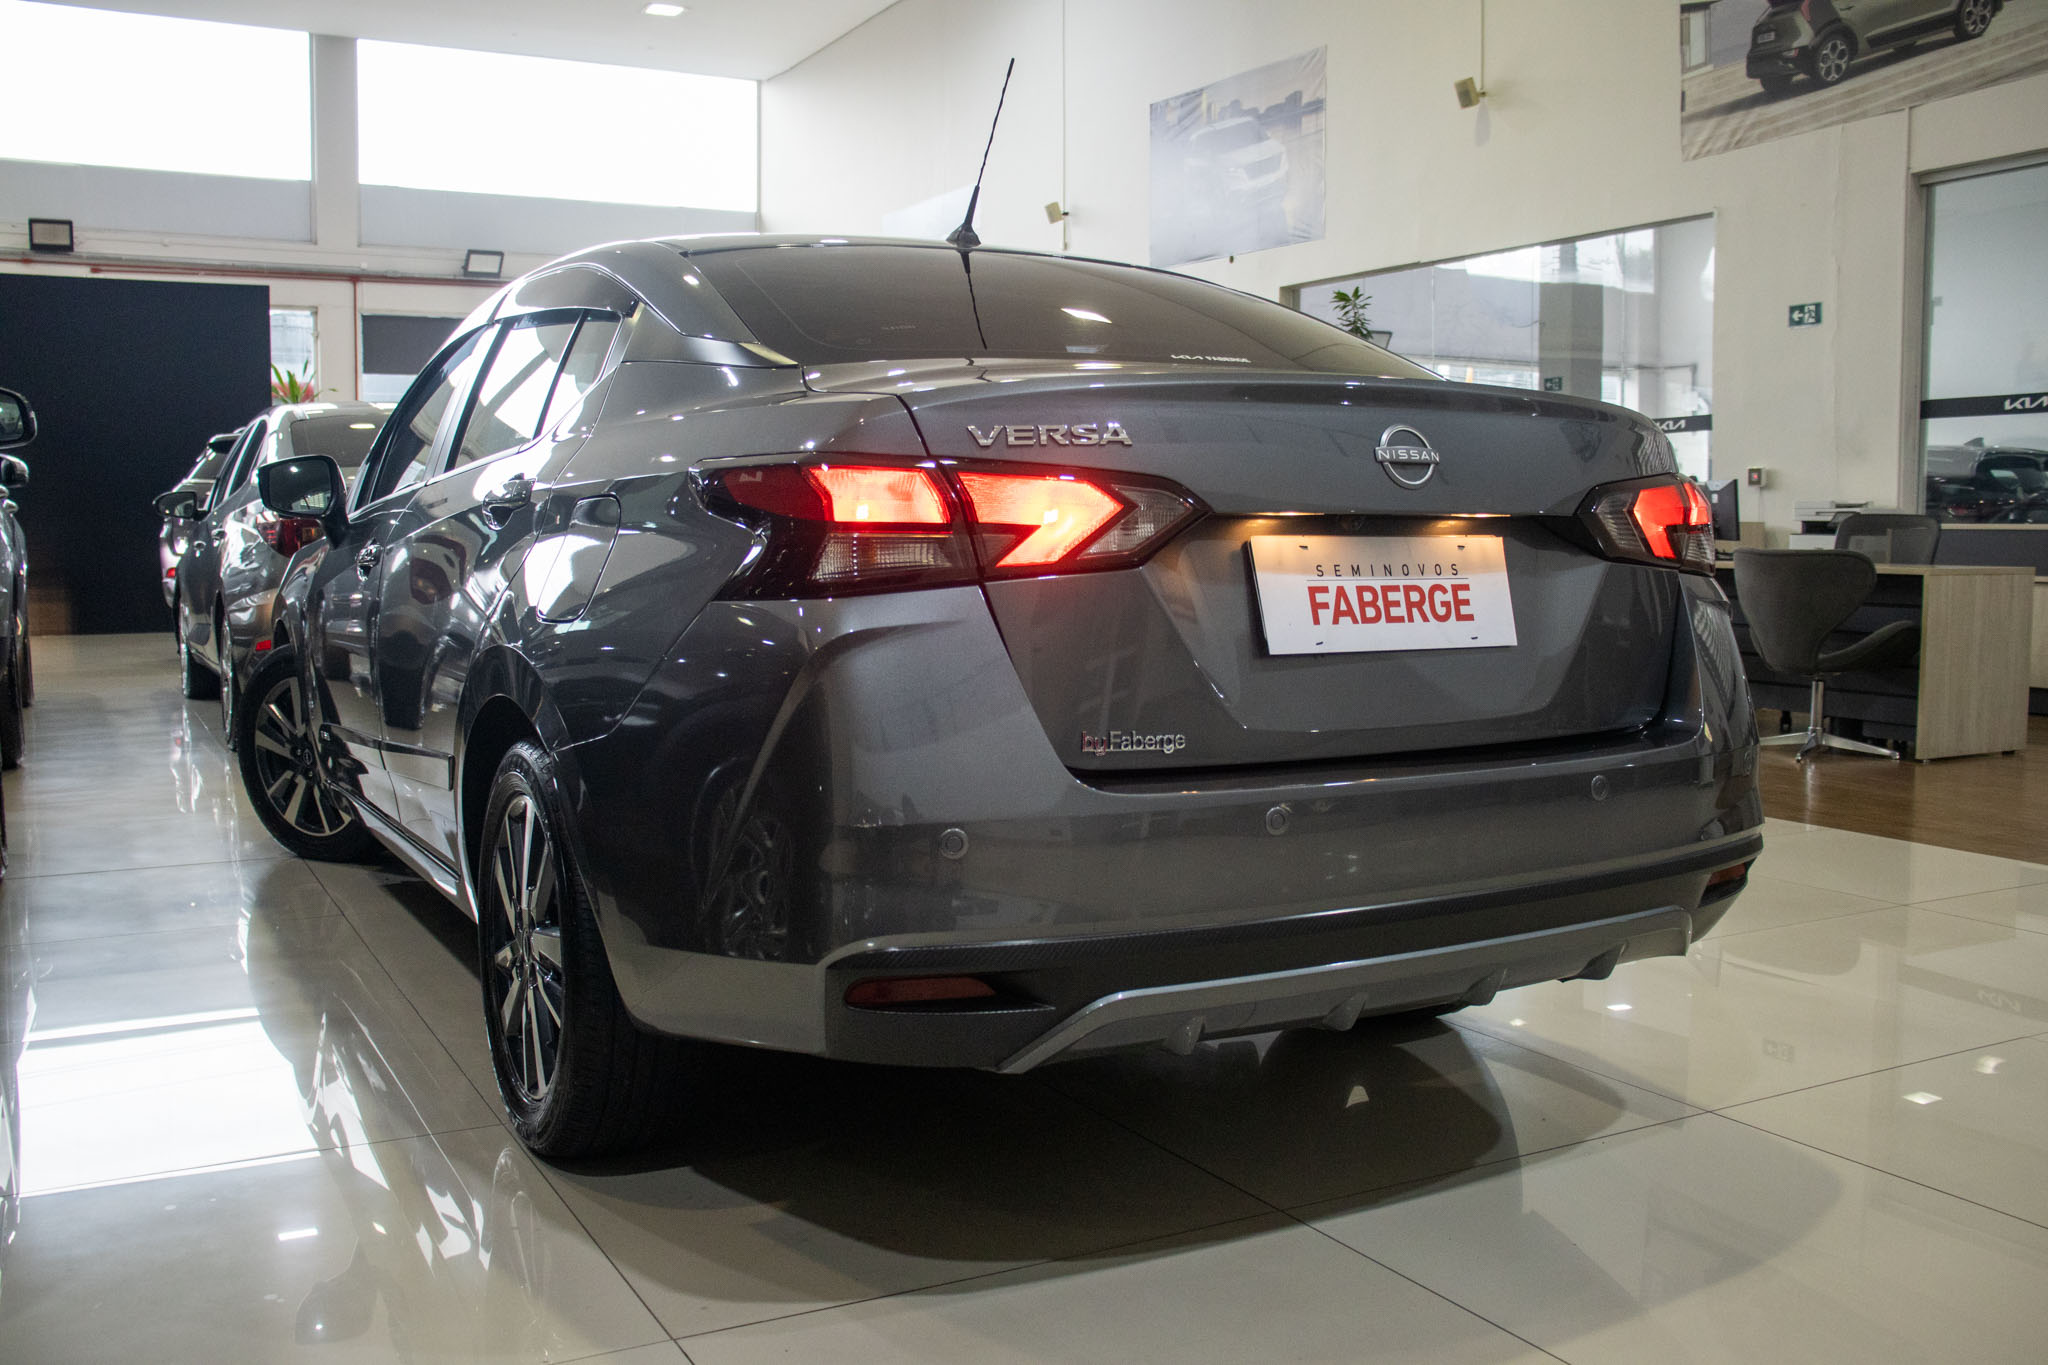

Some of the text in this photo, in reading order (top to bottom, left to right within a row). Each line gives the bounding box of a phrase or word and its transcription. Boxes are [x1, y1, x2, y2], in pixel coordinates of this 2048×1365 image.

[2004, 395, 2048, 411] KIA
[967, 421, 1133, 447] VERSA
[1378, 449, 1440, 462] NISSAN
[1315, 562, 1459, 578] SEMINOVOS
[1307, 583, 1475, 626] FABERGE
